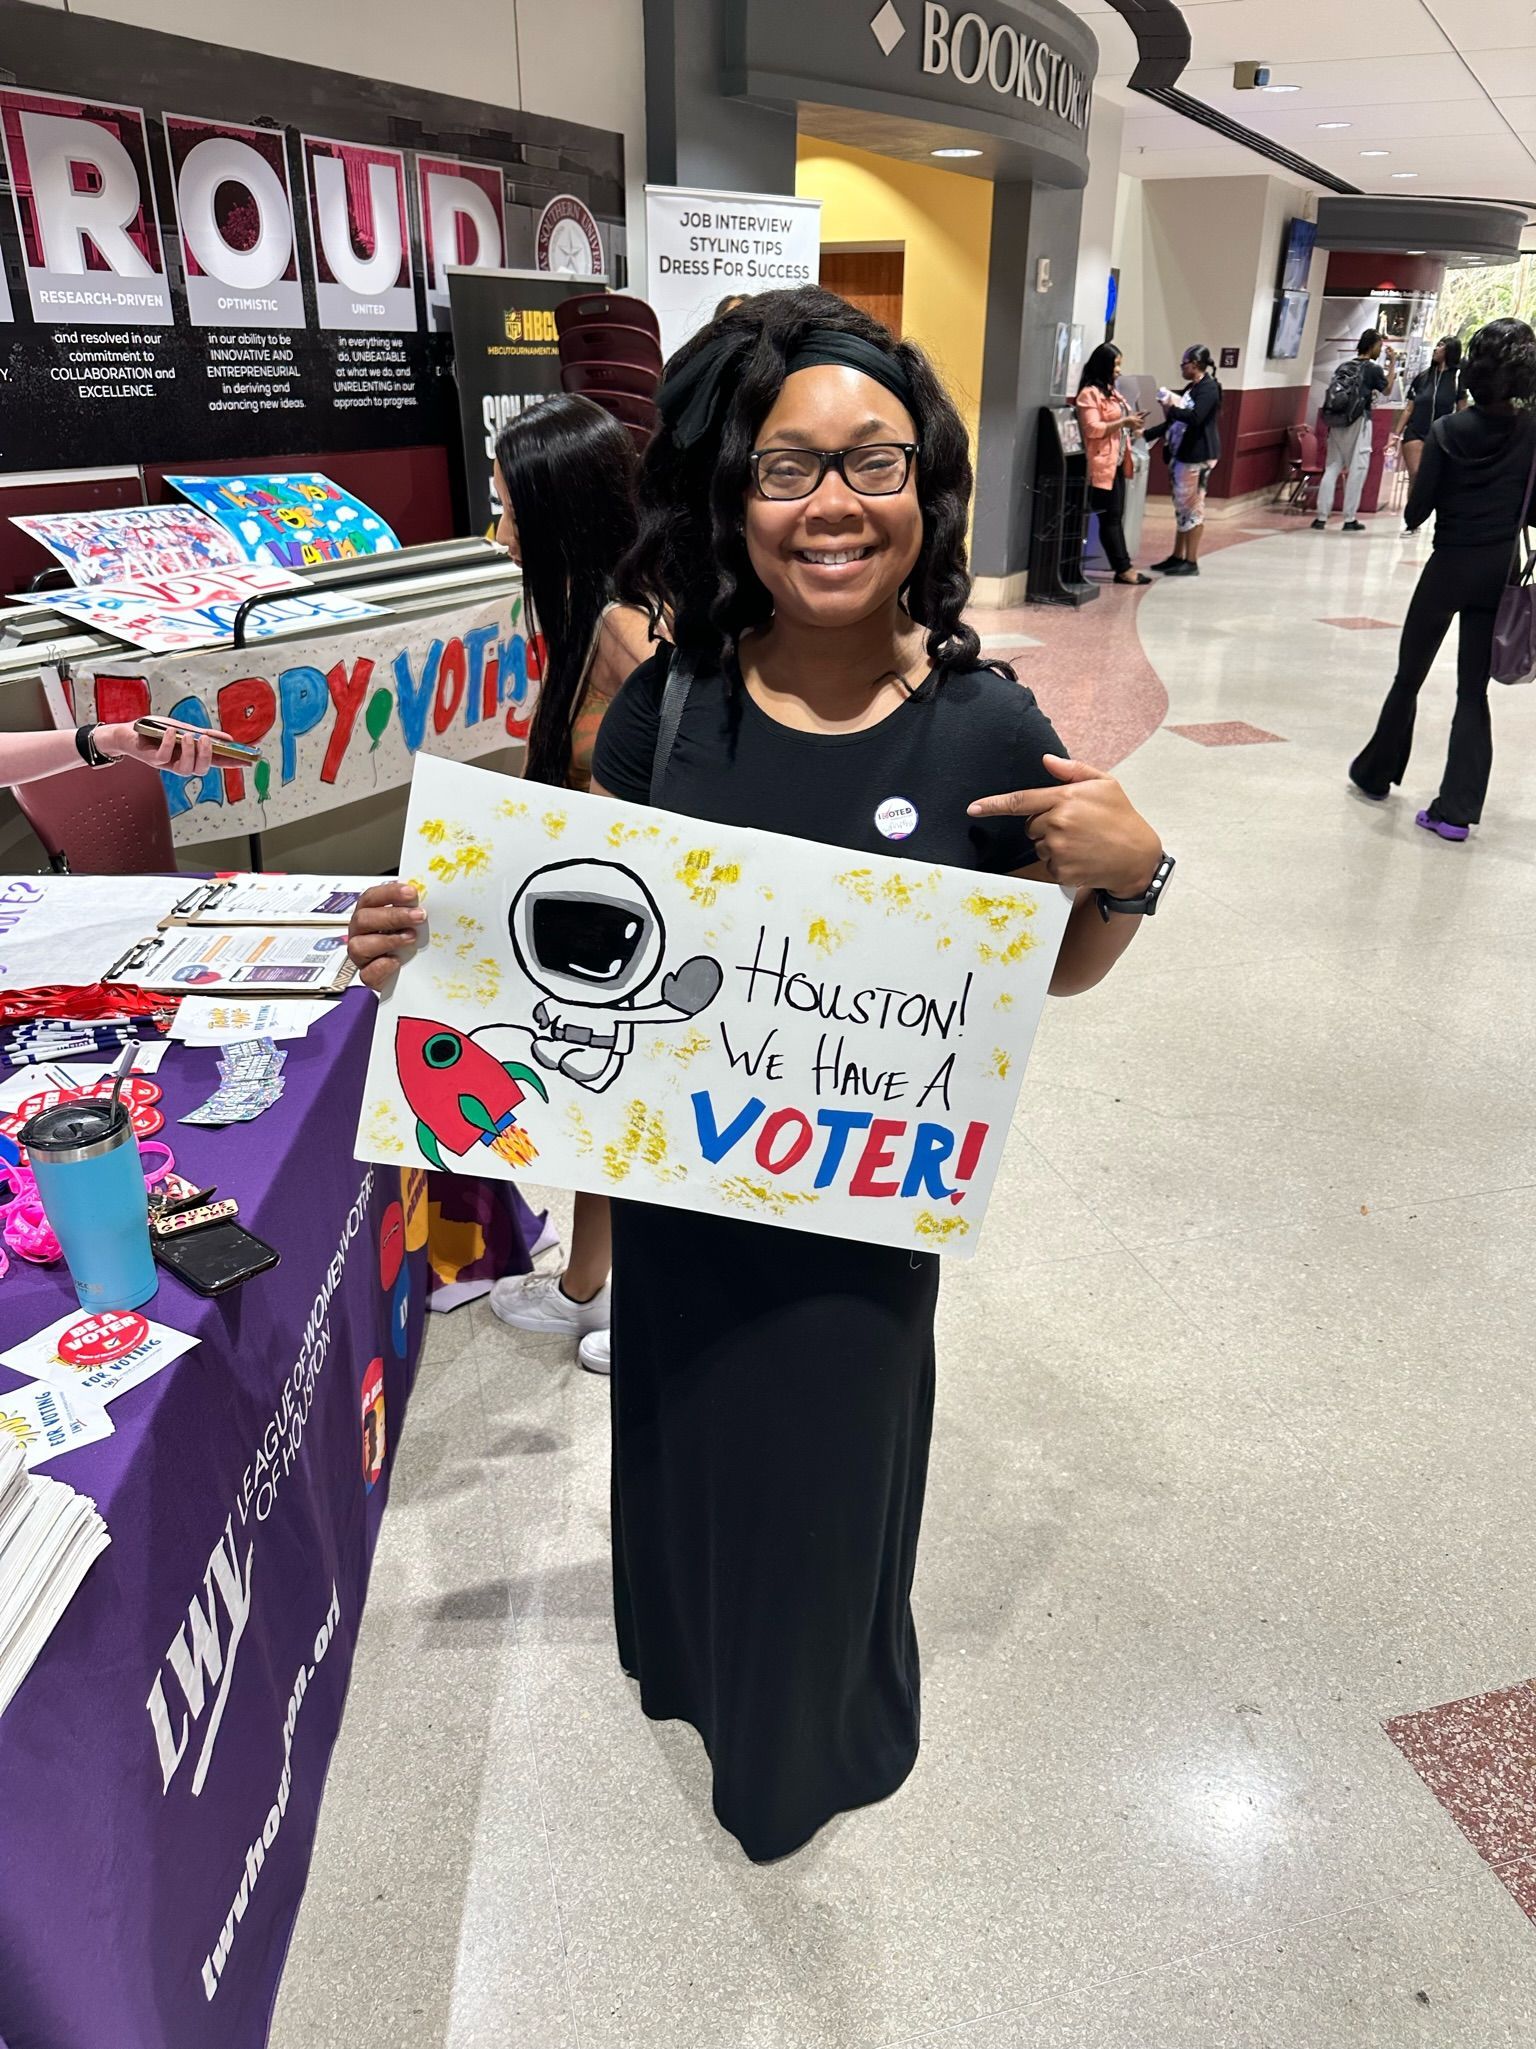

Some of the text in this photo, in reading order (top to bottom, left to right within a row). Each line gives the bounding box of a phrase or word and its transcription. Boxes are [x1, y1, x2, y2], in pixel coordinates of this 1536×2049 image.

[540, 201, 582, 246] SOUTHERN
[680, 212, 793, 233] JOB INTERVIEW
[690, 237, 783, 256] STYLING TIPS
[39, 290, 163, 307] RESEARCH-DRIVEN
[218, 297, 278, 311] OPTIMISTIC
[352, 304, 385, 315] UNITED
[54, 332, 161, 344] and resolved in our
[208, 333, 291, 346] in our ability to be
[338, 336, 403, 350] in everything we
[69, 350, 155, 362] commitment to
[210, 349, 293, 361] INNOVATIVE AND
[338, 351, 406, 362] do, UNBEATABLE
[50, 368, 175, 380] COLLABORATION and
[207, 366, 301, 378] ENTREPRENEURIAL
[336, 367, 411, 378] at what we do, and
[78, 385, 157, 399] EXCELLENCE.
[222, 382, 290, 396] in deriving and
[333, 381, 415, 393] UNRELENTING in our
[209, 398, 306, 413] advancing new ideas.
[333, 397, 372, 409] approach
[373, 397, 382, 406] to
[99, 528, 177, 550] IS AN
[736, 925, 973, 1038] HOUSTON!
[720, 1021, 956, 1111] WE HAVE A
[690, 1091, 990, 1206] VOTER!
[161, 1206, 235, 1232] GOT THIS
[162, 1202, 227, 1223] YOU'VE
[65, 1315, 139, 1351] VOTER
[69, 1313, 119, 1338] BE A
[82, 1371, 113, 1387] FOR
[110, 1339, 162, 1371] VOTING
[237, 1378, 294, 1526] LEAGUE
[293, 1348, 311, 1391] OF
[304, 1240, 345, 1344] WOMEN
[35, 1391, 66, 1447] FOR VOTING
[256, 1318, 332, 1522] OF HOUSTON
[146, 1513, 254, 1797] LWV
